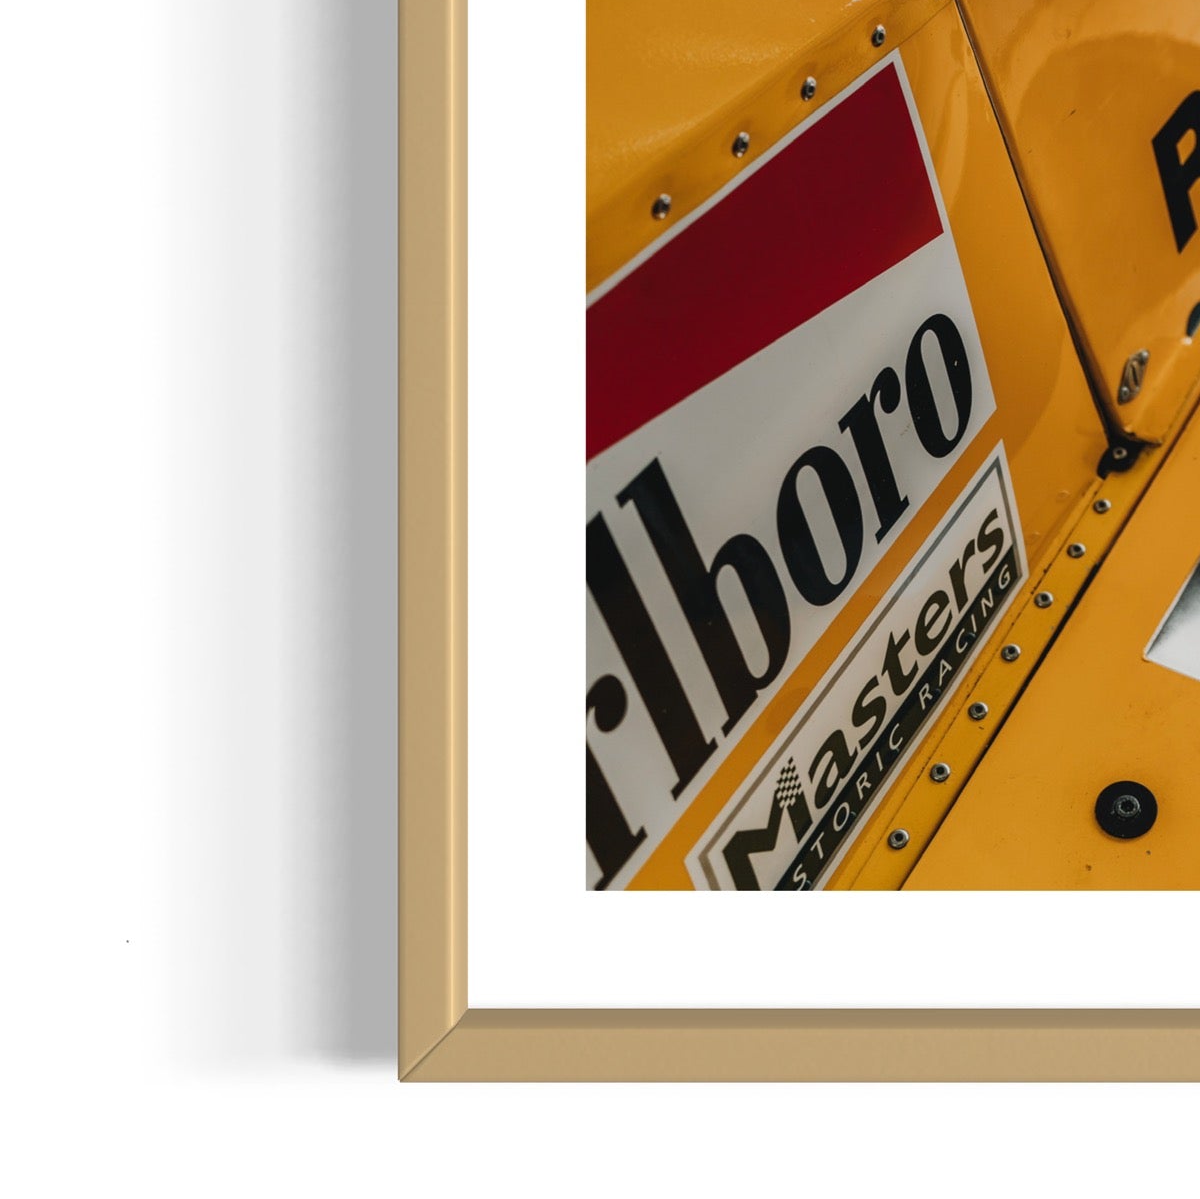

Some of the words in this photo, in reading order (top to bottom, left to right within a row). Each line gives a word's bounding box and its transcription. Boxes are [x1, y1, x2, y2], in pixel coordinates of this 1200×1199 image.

[722, 508, 1004, 890] Masters
[793, 723, 904, 890] STORIC
[918, 563, 1011, 710] RACING
